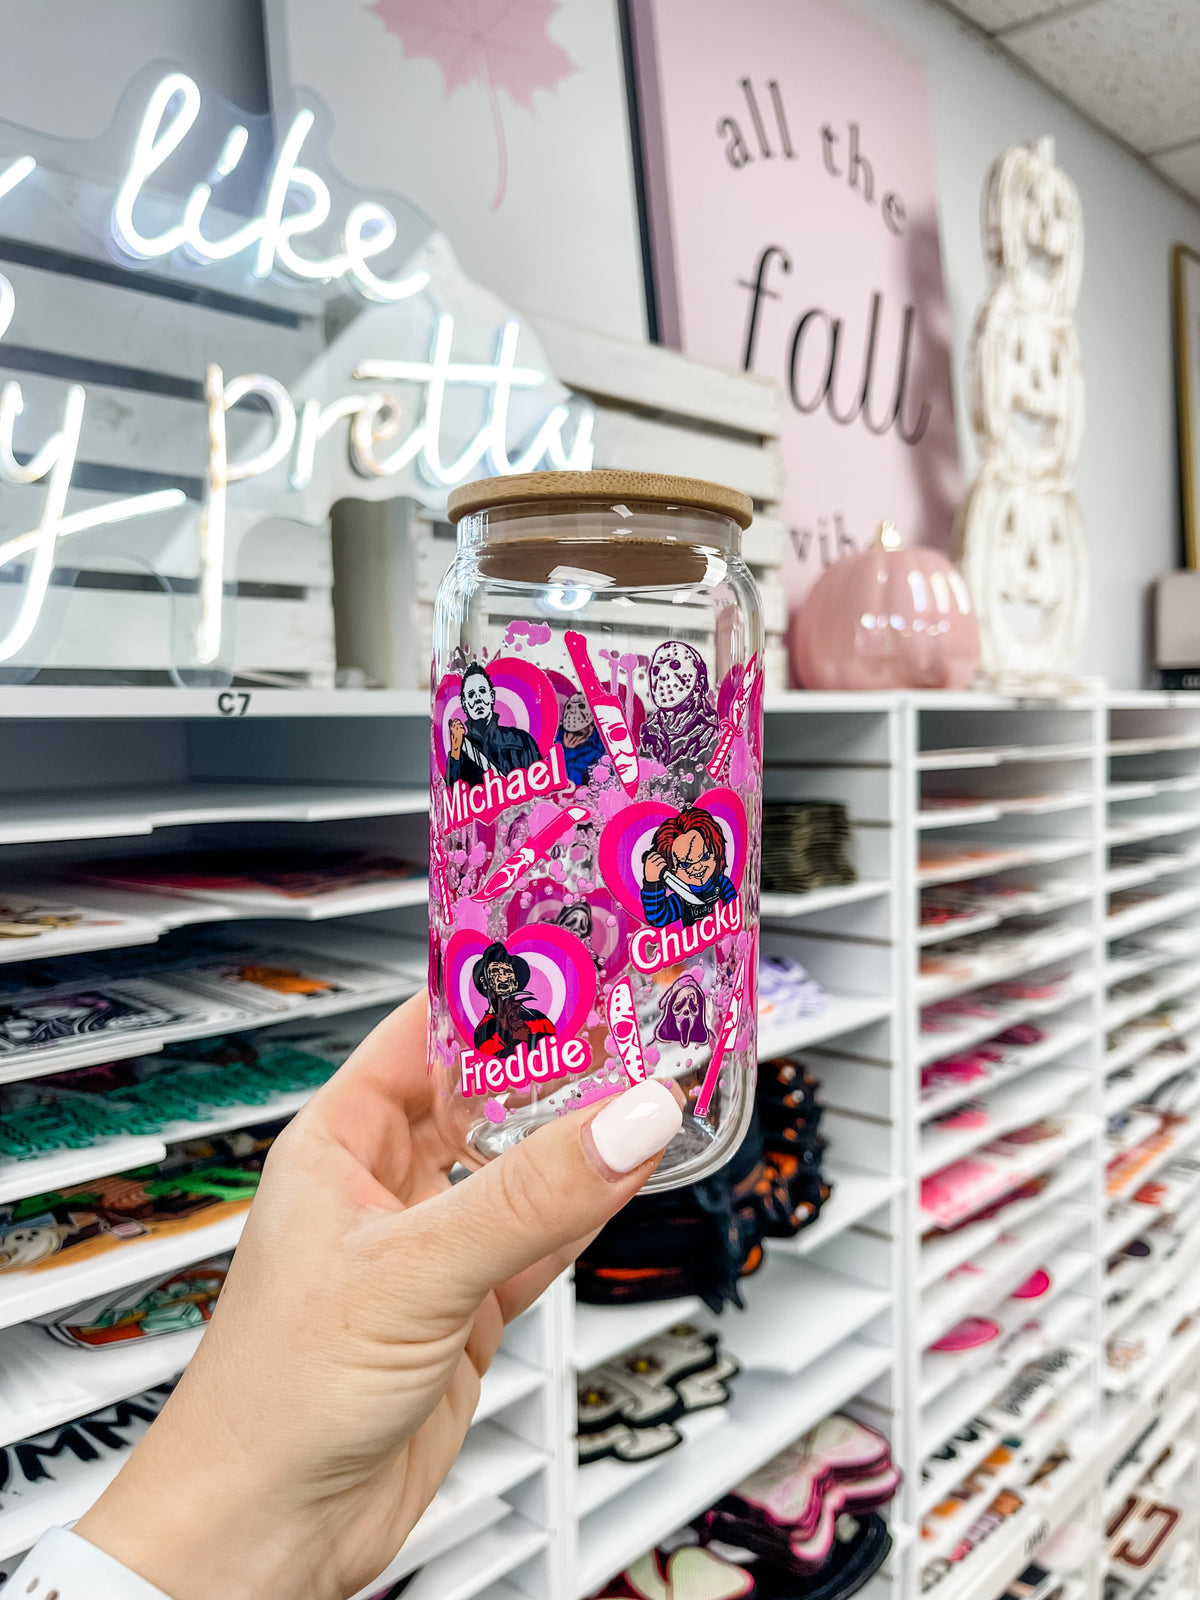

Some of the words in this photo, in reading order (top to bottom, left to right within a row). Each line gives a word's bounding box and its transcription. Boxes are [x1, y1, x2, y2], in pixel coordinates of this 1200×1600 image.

[113, 72, 431, 303] like
[716, 77, 798, 171] all
[819, 120, 907, 238] the
[735, 245, 932, 447] fall
[217, 693, 252, 717] C7
[442, 746, 562, 830] Michael
[631, 894, 741, 970] Chucky
[460, 1036, 586, 1092] Freddie
